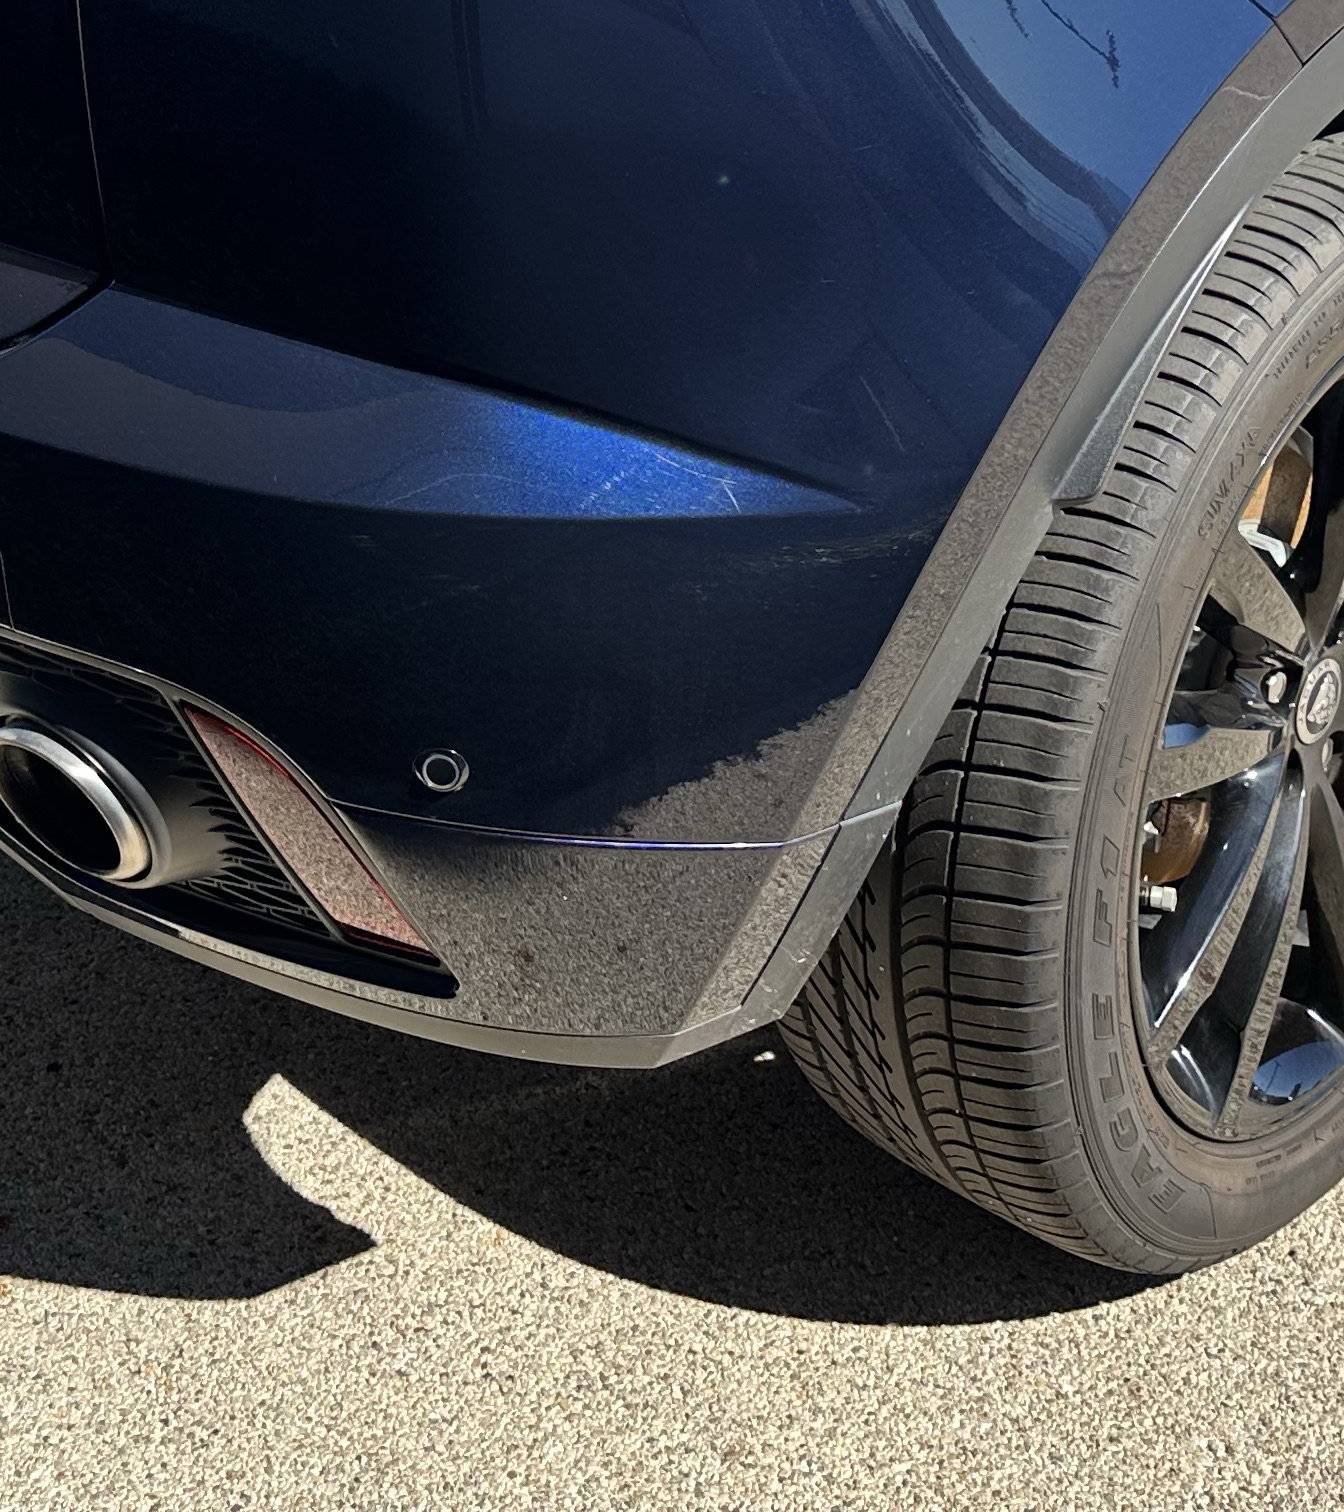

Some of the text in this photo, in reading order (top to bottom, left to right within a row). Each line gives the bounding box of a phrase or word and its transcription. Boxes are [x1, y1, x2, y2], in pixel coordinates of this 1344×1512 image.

[1092, 734, 1187, 1214] EAGLE F1 AT
